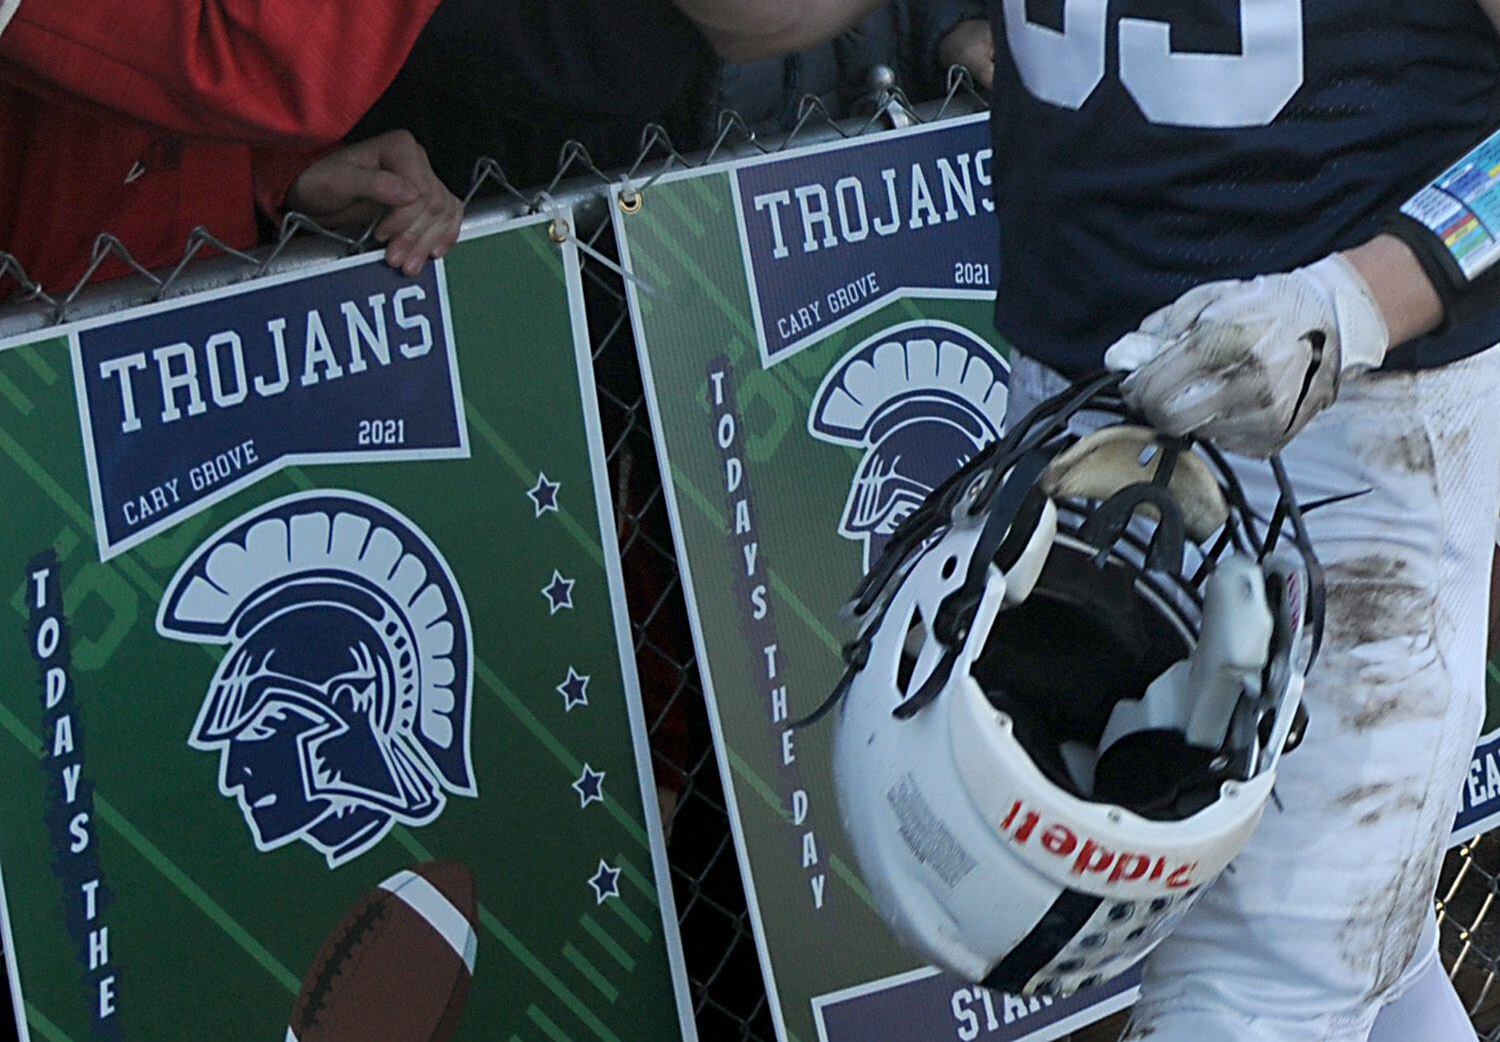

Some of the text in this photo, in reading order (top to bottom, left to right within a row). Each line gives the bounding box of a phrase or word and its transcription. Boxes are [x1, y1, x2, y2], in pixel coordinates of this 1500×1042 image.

[777, 271, 880, 340] CARY GROVE
[954, 262, 990, 285] 2021
[99, 285, 433, 433] TROJANS
[358, 419, 405, 444] 2021
[123, 439, 259, 525] CARY GROVE
[711, 370, 825, 909] TODAYS THE DAY
[32, 568, 115, 1019] TODAYS THE
